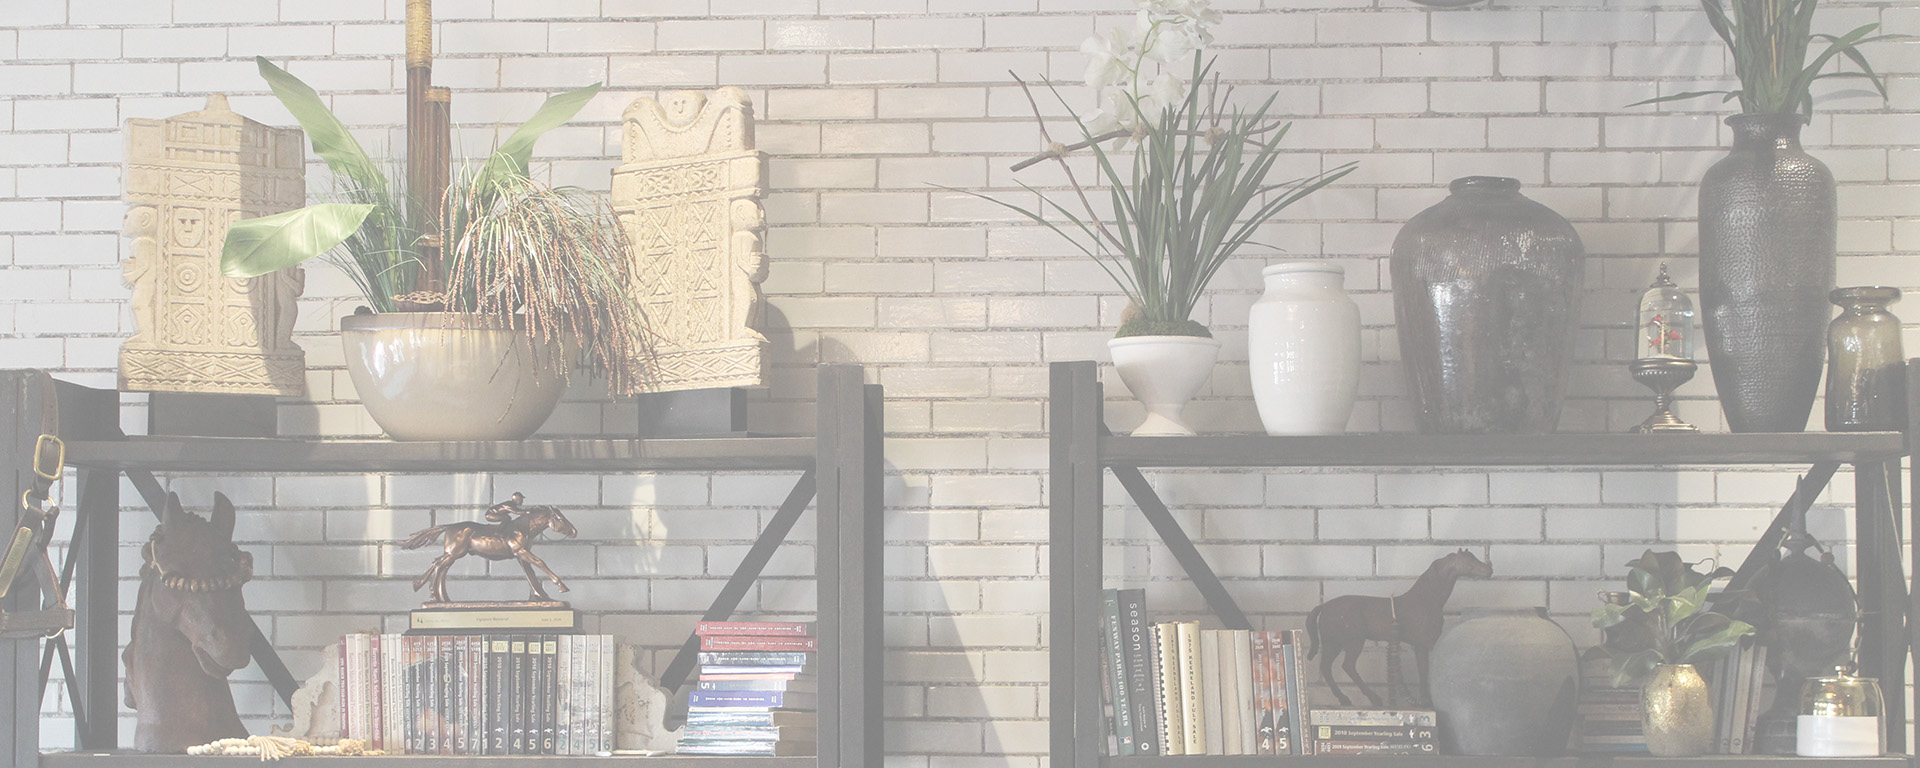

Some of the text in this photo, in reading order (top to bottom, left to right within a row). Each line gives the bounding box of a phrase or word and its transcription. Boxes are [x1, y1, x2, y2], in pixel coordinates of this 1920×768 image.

[1130, 603, 1141, 651] season
[1111, 616, 1120, 651] FENWAY
[1120, 698, 1128, 727] YEARS
[415, 739, 421, 749] 2
[430, 739, 435, 749] 3
[444, 738, 450, 749] 4
[458, 738, 464, 748] 5
[471, 739, 478, 749] 7
[496, 738, 502, 749] 2
[513, 739, 521, 749] 4
[529, 739, 536, 750] 5
[544, 738, 551, 749] 6
[559, 740, 565, 750] 2
[574, 740, 581, 750] 4
[590, 739, 596, 749] 5
[604, 740, 610, 750] 6
[1262, 738, 1269, 750] 4
[1280, 738, 1287, 749] 5
